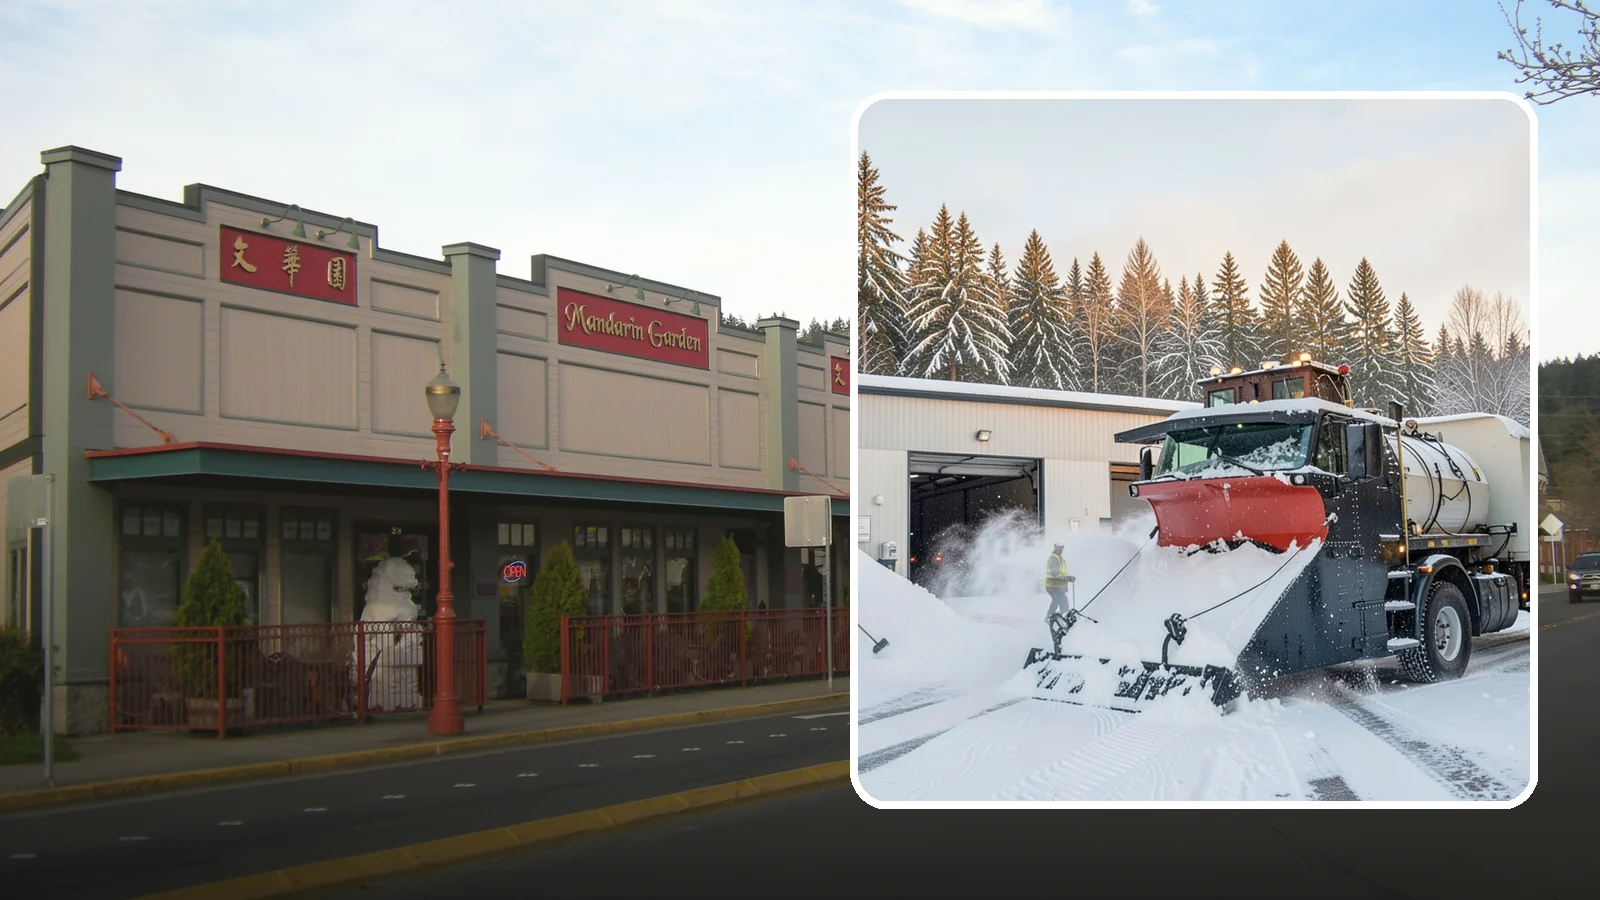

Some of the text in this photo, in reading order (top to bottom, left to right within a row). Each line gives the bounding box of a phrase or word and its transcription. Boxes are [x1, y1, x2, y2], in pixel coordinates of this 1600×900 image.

[231, 236, 346, 290] 文華園
[565, 302, 701, 352] Mandarin Garden
[503, 565, 527, 578] OPEN
